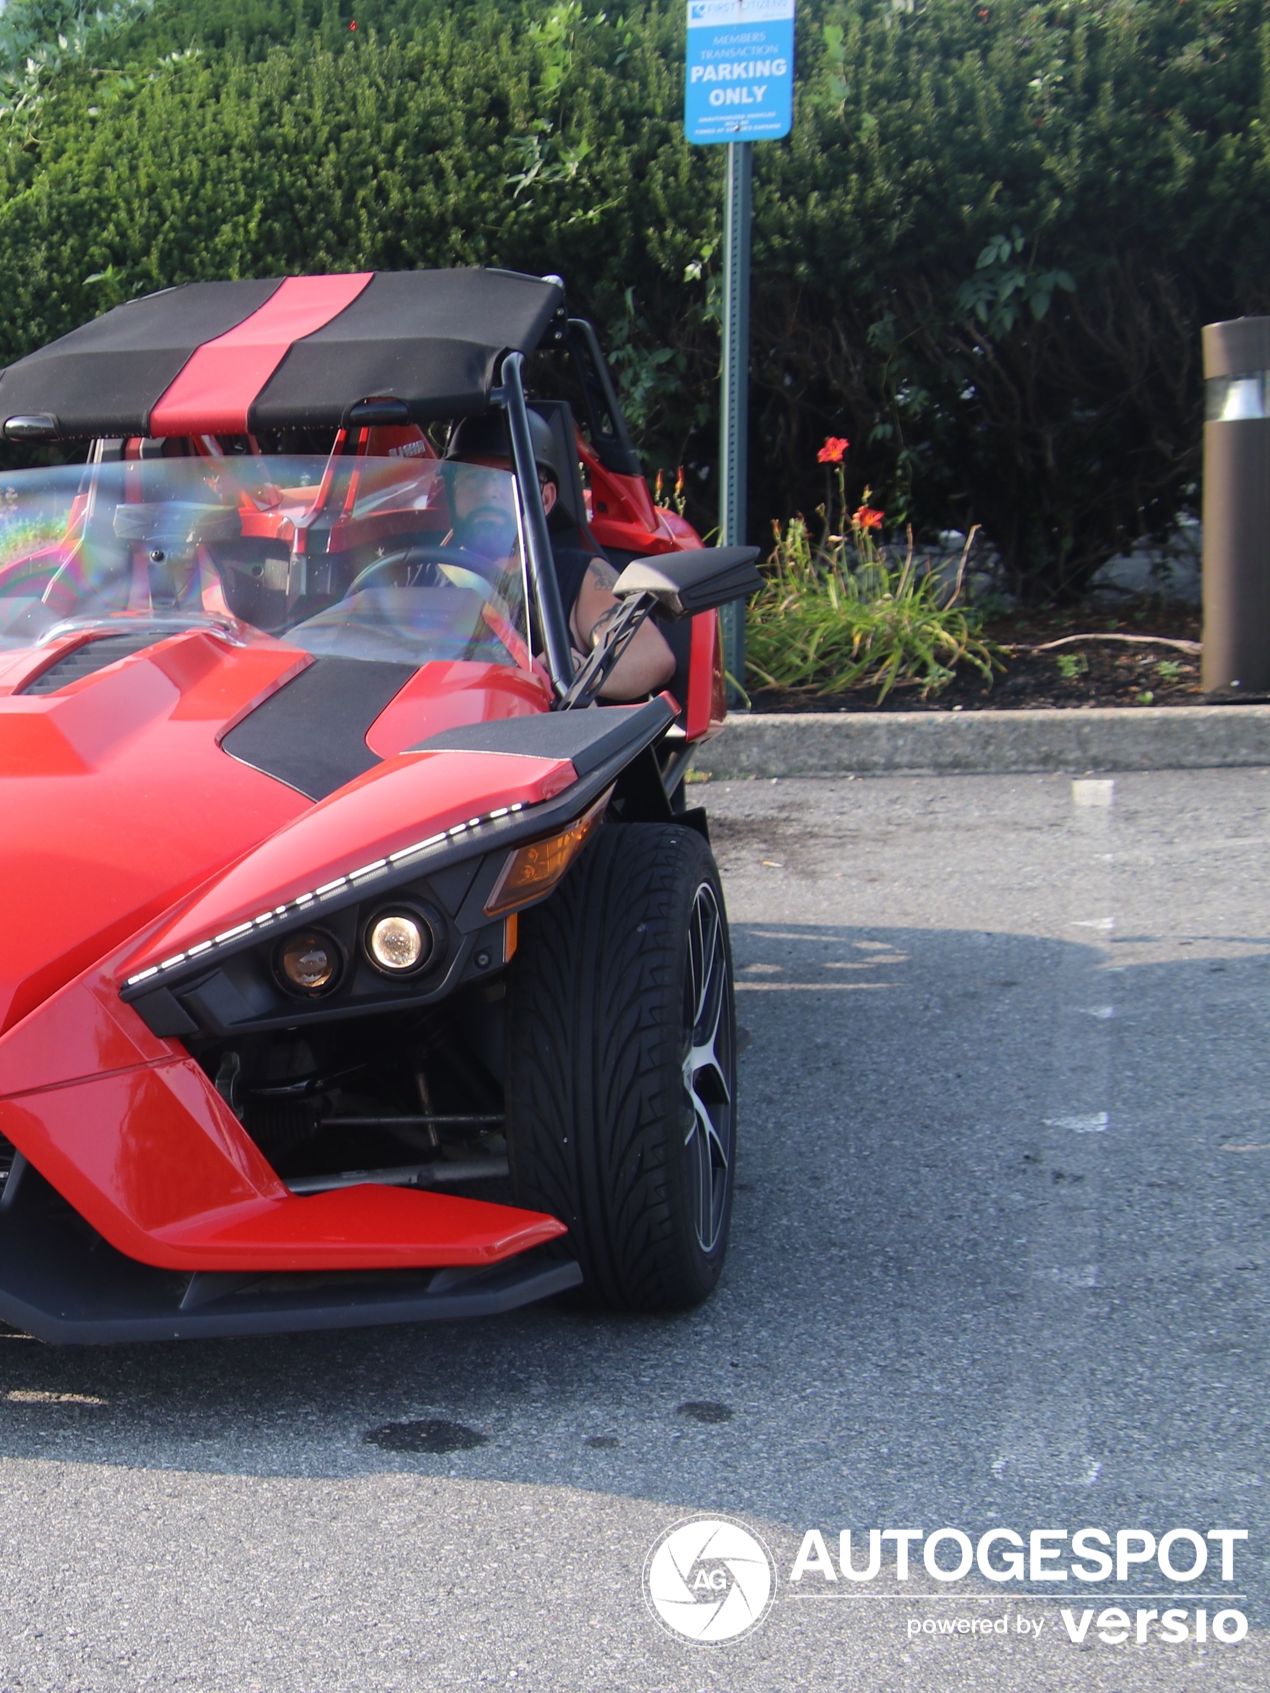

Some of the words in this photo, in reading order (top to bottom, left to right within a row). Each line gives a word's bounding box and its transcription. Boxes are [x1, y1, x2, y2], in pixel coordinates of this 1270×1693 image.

[714, 31, 765, 44] MEMBERS
[701, 44, 778, 59] TRANSACTION
[691, 58, 788, 84] PARKING
[709, 85, 768, 106] ONLY
